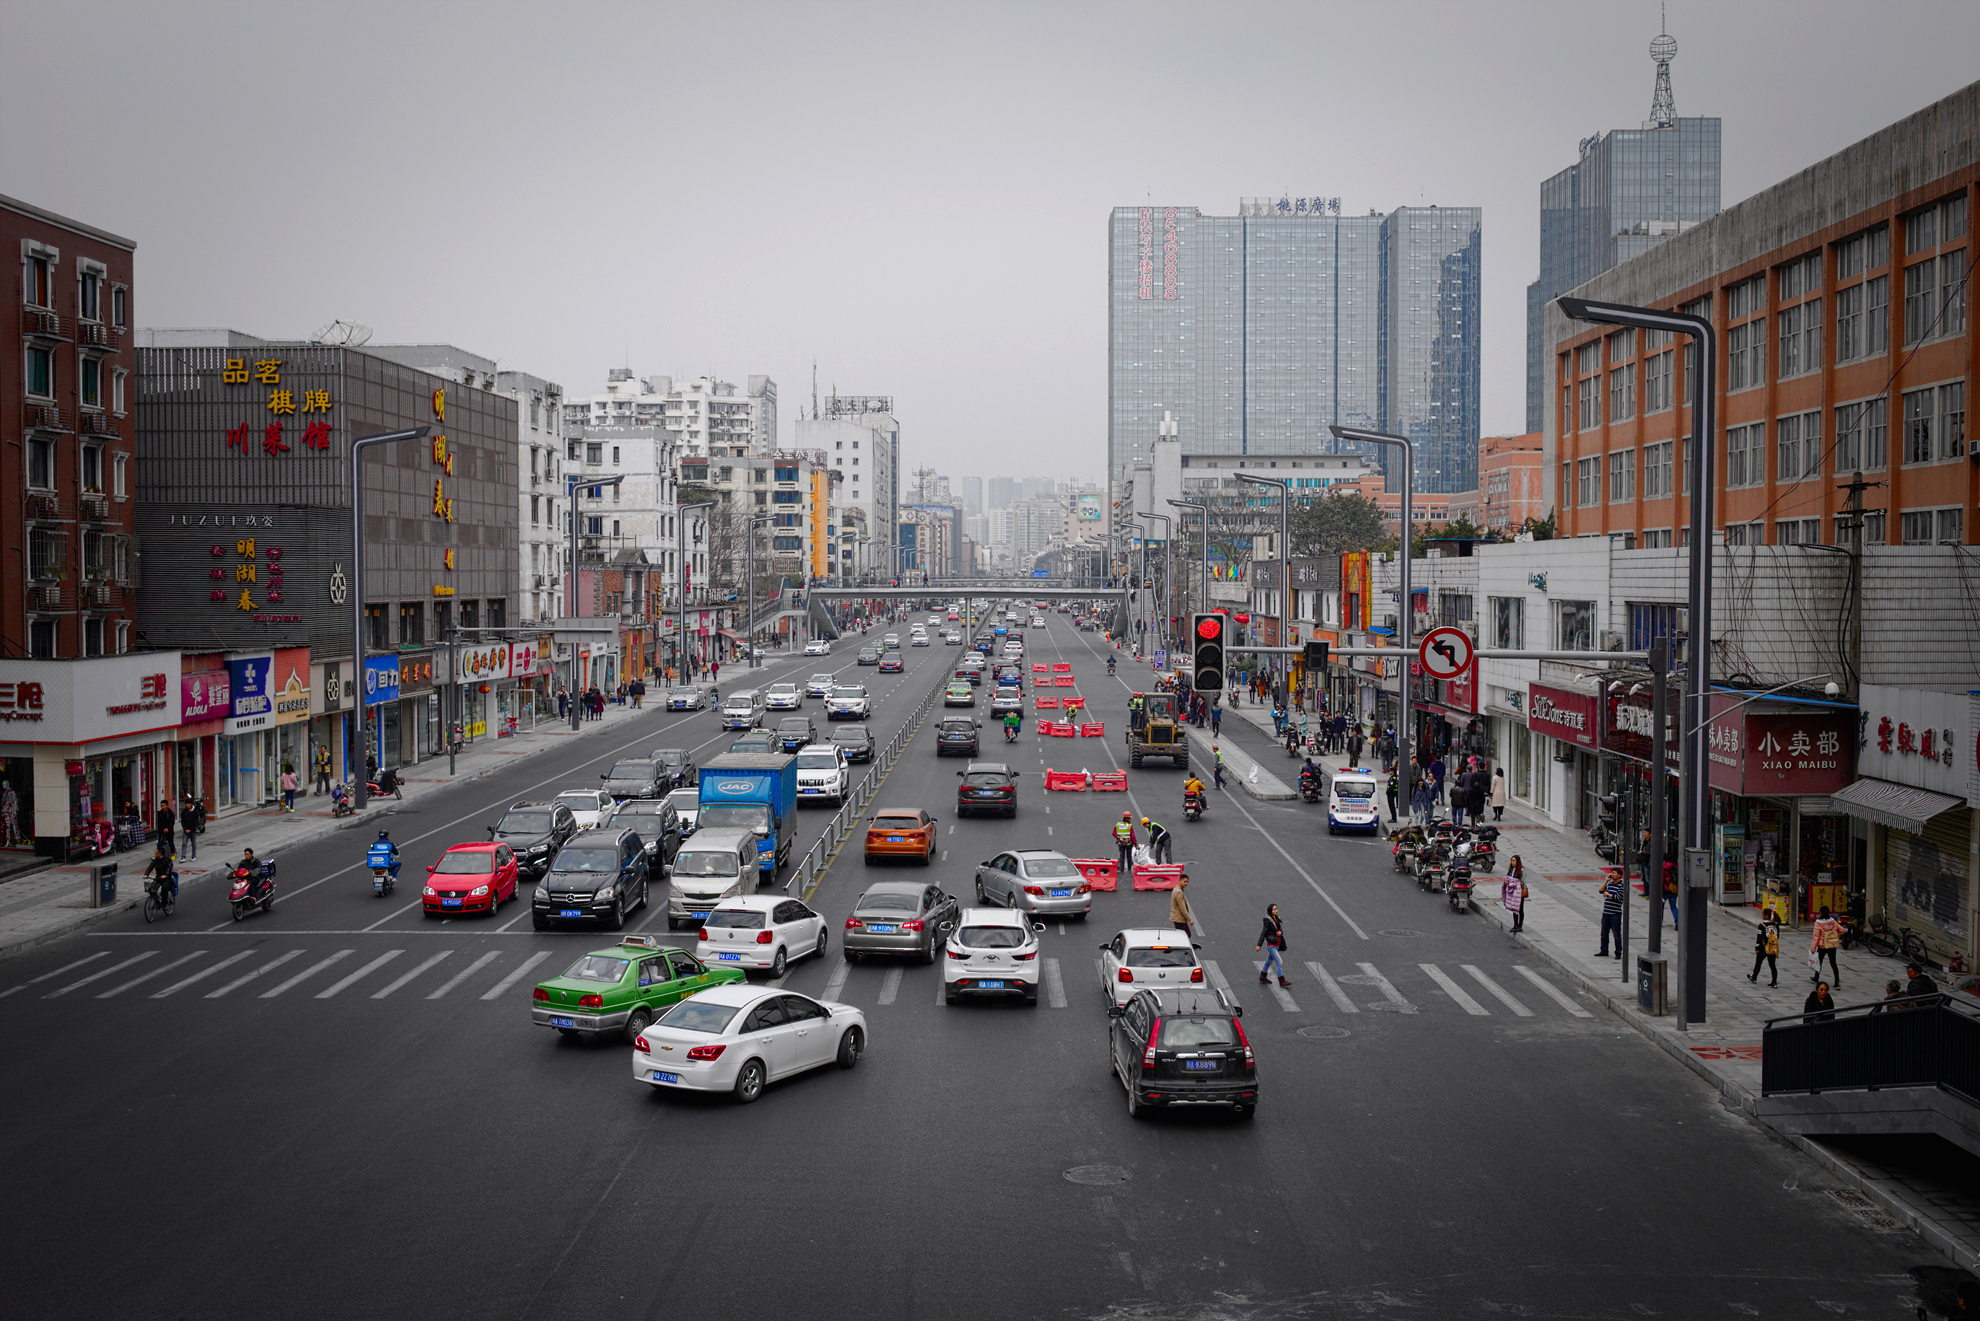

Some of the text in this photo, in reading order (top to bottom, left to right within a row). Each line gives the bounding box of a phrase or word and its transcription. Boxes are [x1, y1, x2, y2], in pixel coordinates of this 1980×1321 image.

[1276, 196, 1340, 213] 桃源廣場
[1138, 207, 1153, 300] 精装写字楼招租
[1163, 207, 1177, 300] 85468888
[222, 358, 282, 384] 品茗
[267, 388, 332, 415] 棋牌
[226, 419, 332, 456] 川菜馆
[433, 388, 446, 518] 明湖春
[168, 515, 237, 527] JUZUI
[236, 537, 259, 611] 明湖春
[266, 546, 284, 603] 特色川菜
[140, 673, 167, 699] 三枪
[378, 669, 398, 689] 回力
[0, 681, 44, 709] 三枪
[185, 704, 208, 717] ALDOLA
[1758, 730, 1840, 757] 小卖部
[1762, 760, 1837, 770] XIAO MAIBU
